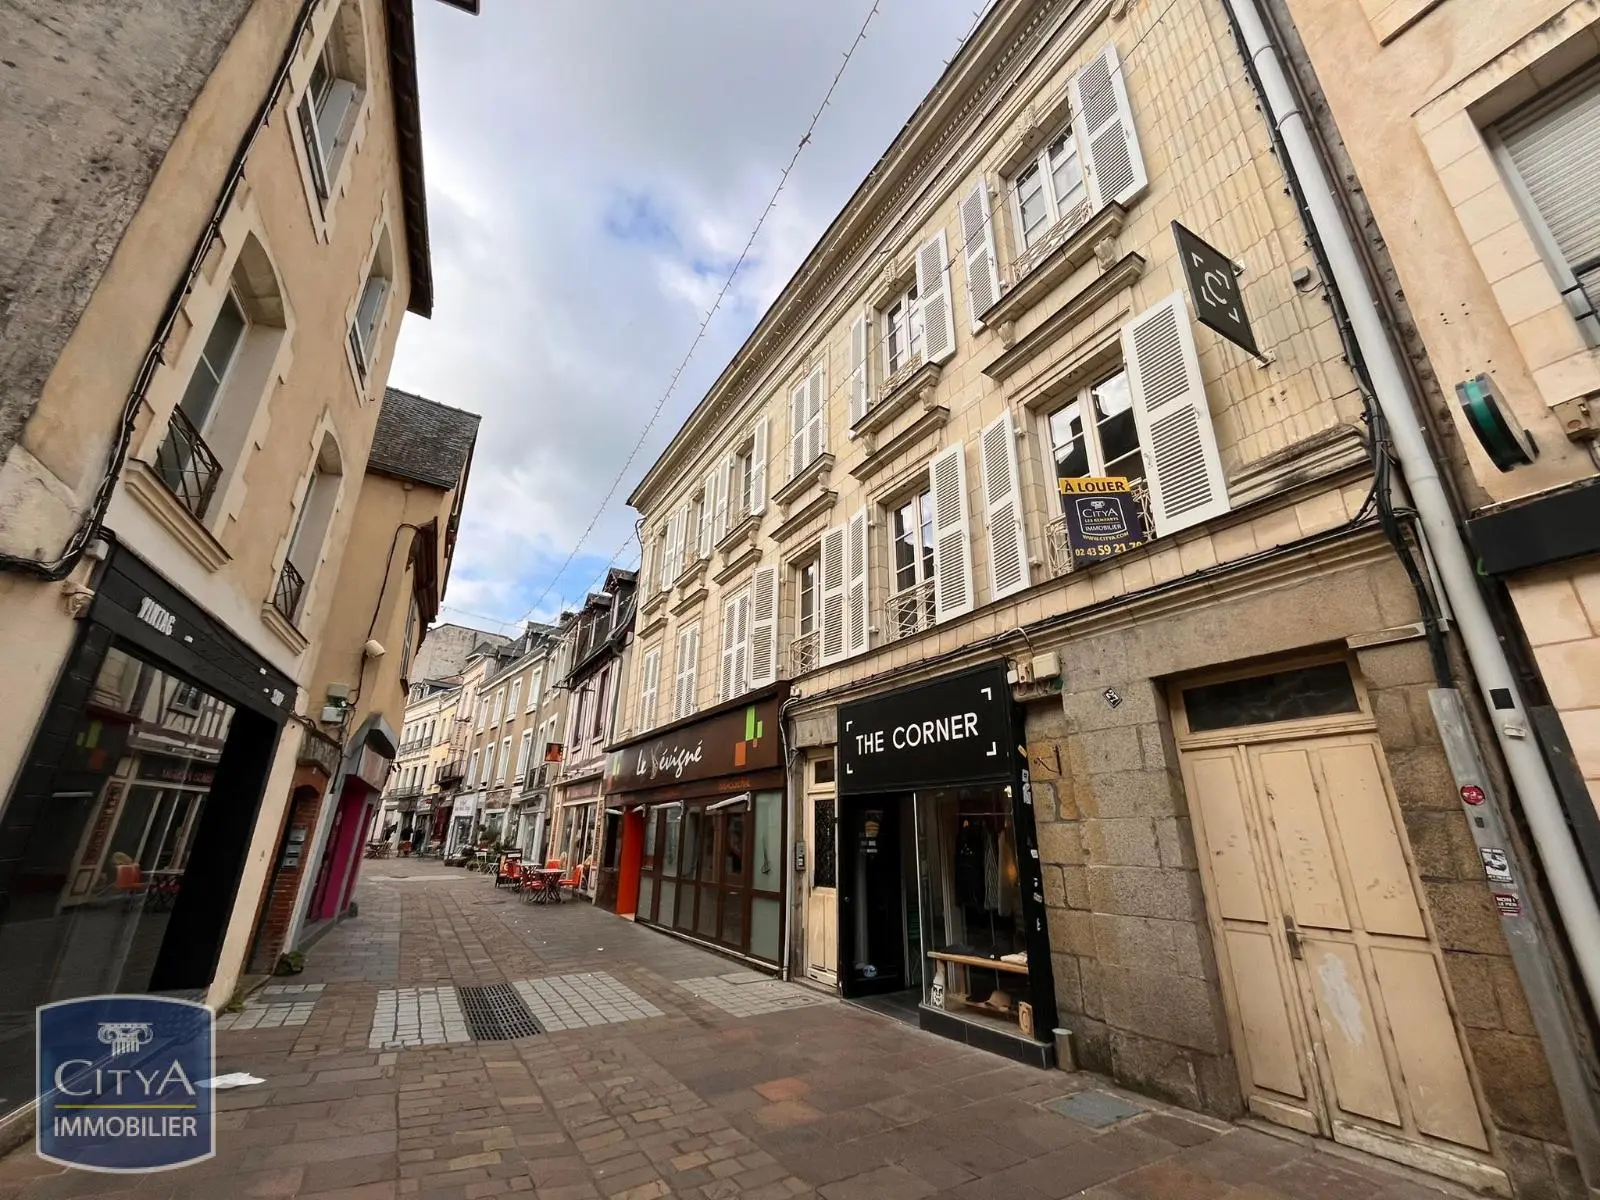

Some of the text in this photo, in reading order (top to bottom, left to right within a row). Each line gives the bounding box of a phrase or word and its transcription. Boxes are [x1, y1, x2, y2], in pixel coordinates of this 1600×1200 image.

[1065, 480, 1125, 493] À LOUER
[1085, 524, 1122, 532] IMMOBILIER
[1075, 548, 1085, 556] 02
[1086, 547, 1097, 556] 43
[1097, 544, 1112, 556] 59
[1113, 543, 1127, 553] 21
[1105, 689, 1119, 704] 27
[856, 712, 978, 755] THE CORNER
[650, 740, 703, 780] Sévigné
